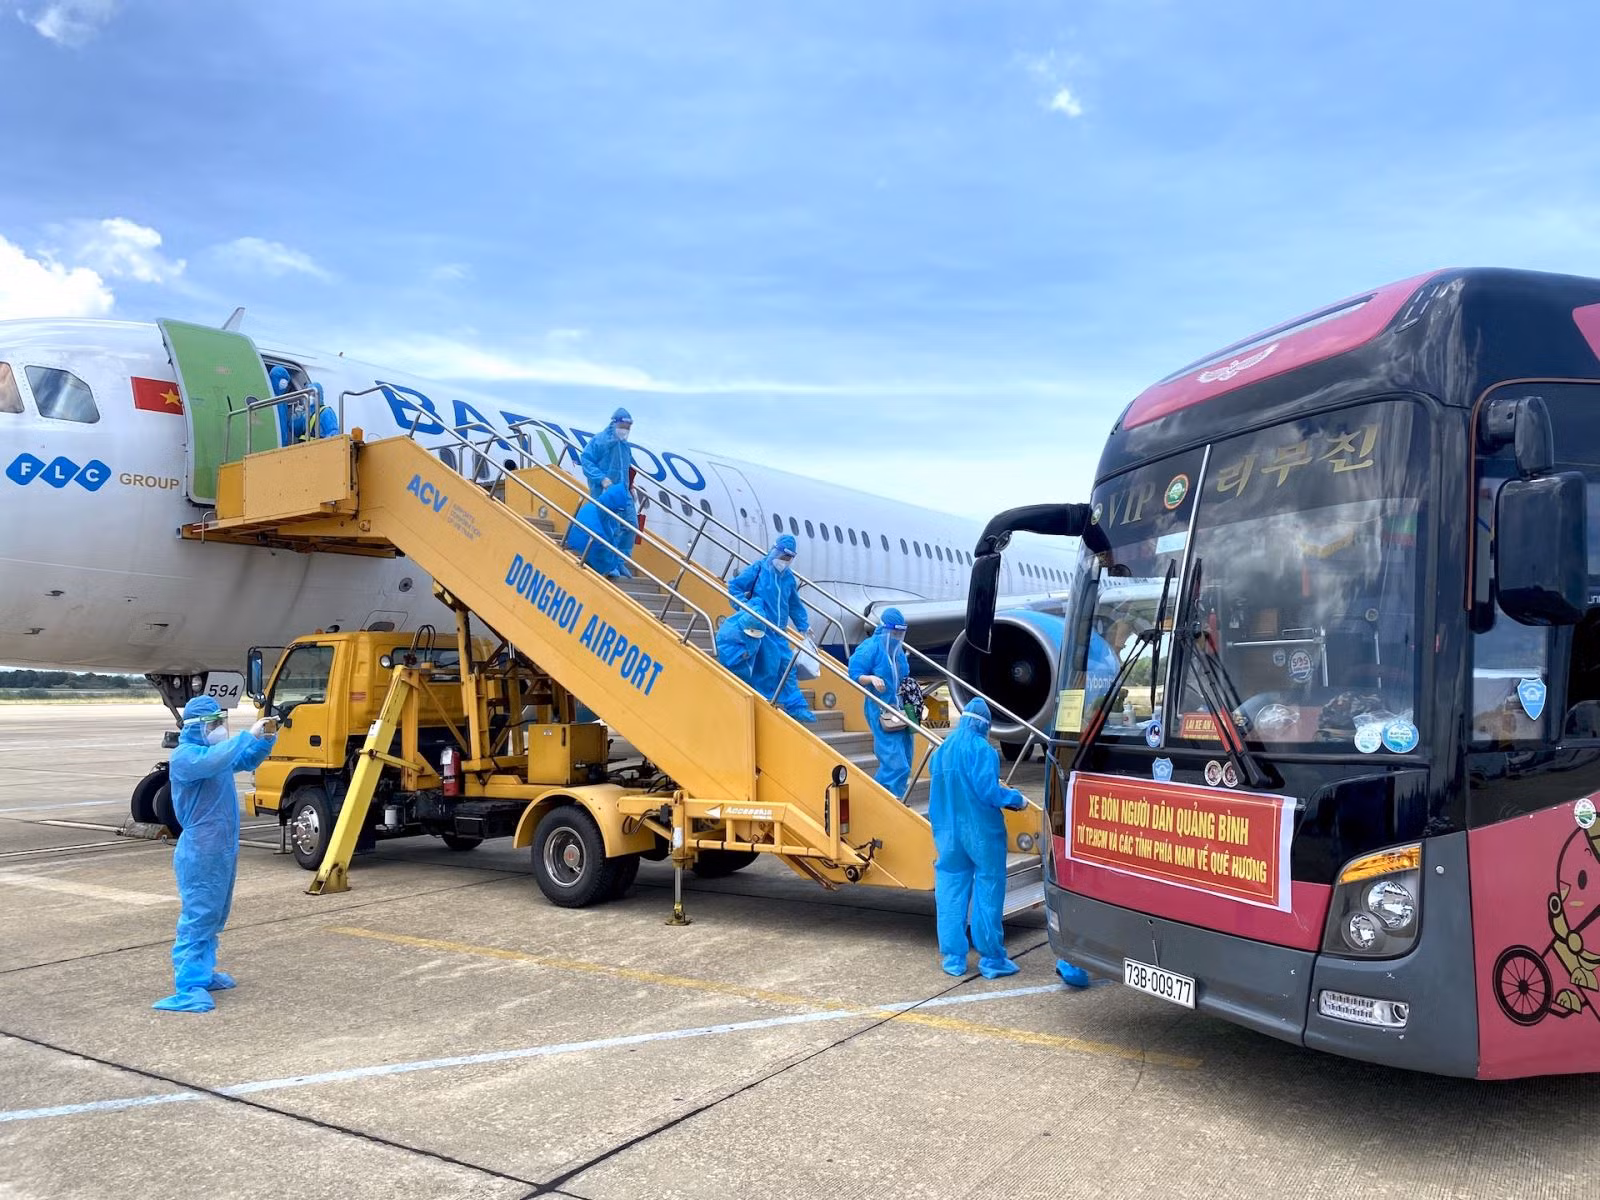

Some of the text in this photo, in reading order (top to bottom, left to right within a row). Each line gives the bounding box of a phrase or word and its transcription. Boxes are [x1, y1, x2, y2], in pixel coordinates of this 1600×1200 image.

[119, 472, 180, 490] GROUP
[1217, 424, 1378, 497] 리무진
[407, 474, 448, 513] ACV
[1109, 481, 1156, 528] VIP
[505, 553, 664, 696] DONGHOI AIRPORT
[208, 684, 239, 698] 594
[1089, 793, 1250, 846] XE ĐÓN NGƯỜI DÂN QUẢNG BÌNH
[1077, 822, 1086, 845] TỪ
[1085, 826, 1109, 850] TP.HCM
[1109, 828, 1118, 852] VÀ
[1119, 831, 1134, 856] CÁC
[1135, 832, 1153, 860] TỈNH
[1153, 839, 1173, 864] PHÍA
[1174, 844, 1196, 869] NAM
[1210, 849, 1230, 876] QUÊ
[1231, 855, 1268, 884] HƯƠNG
[1126, 963, 1191, 1003] 73B-009.77
